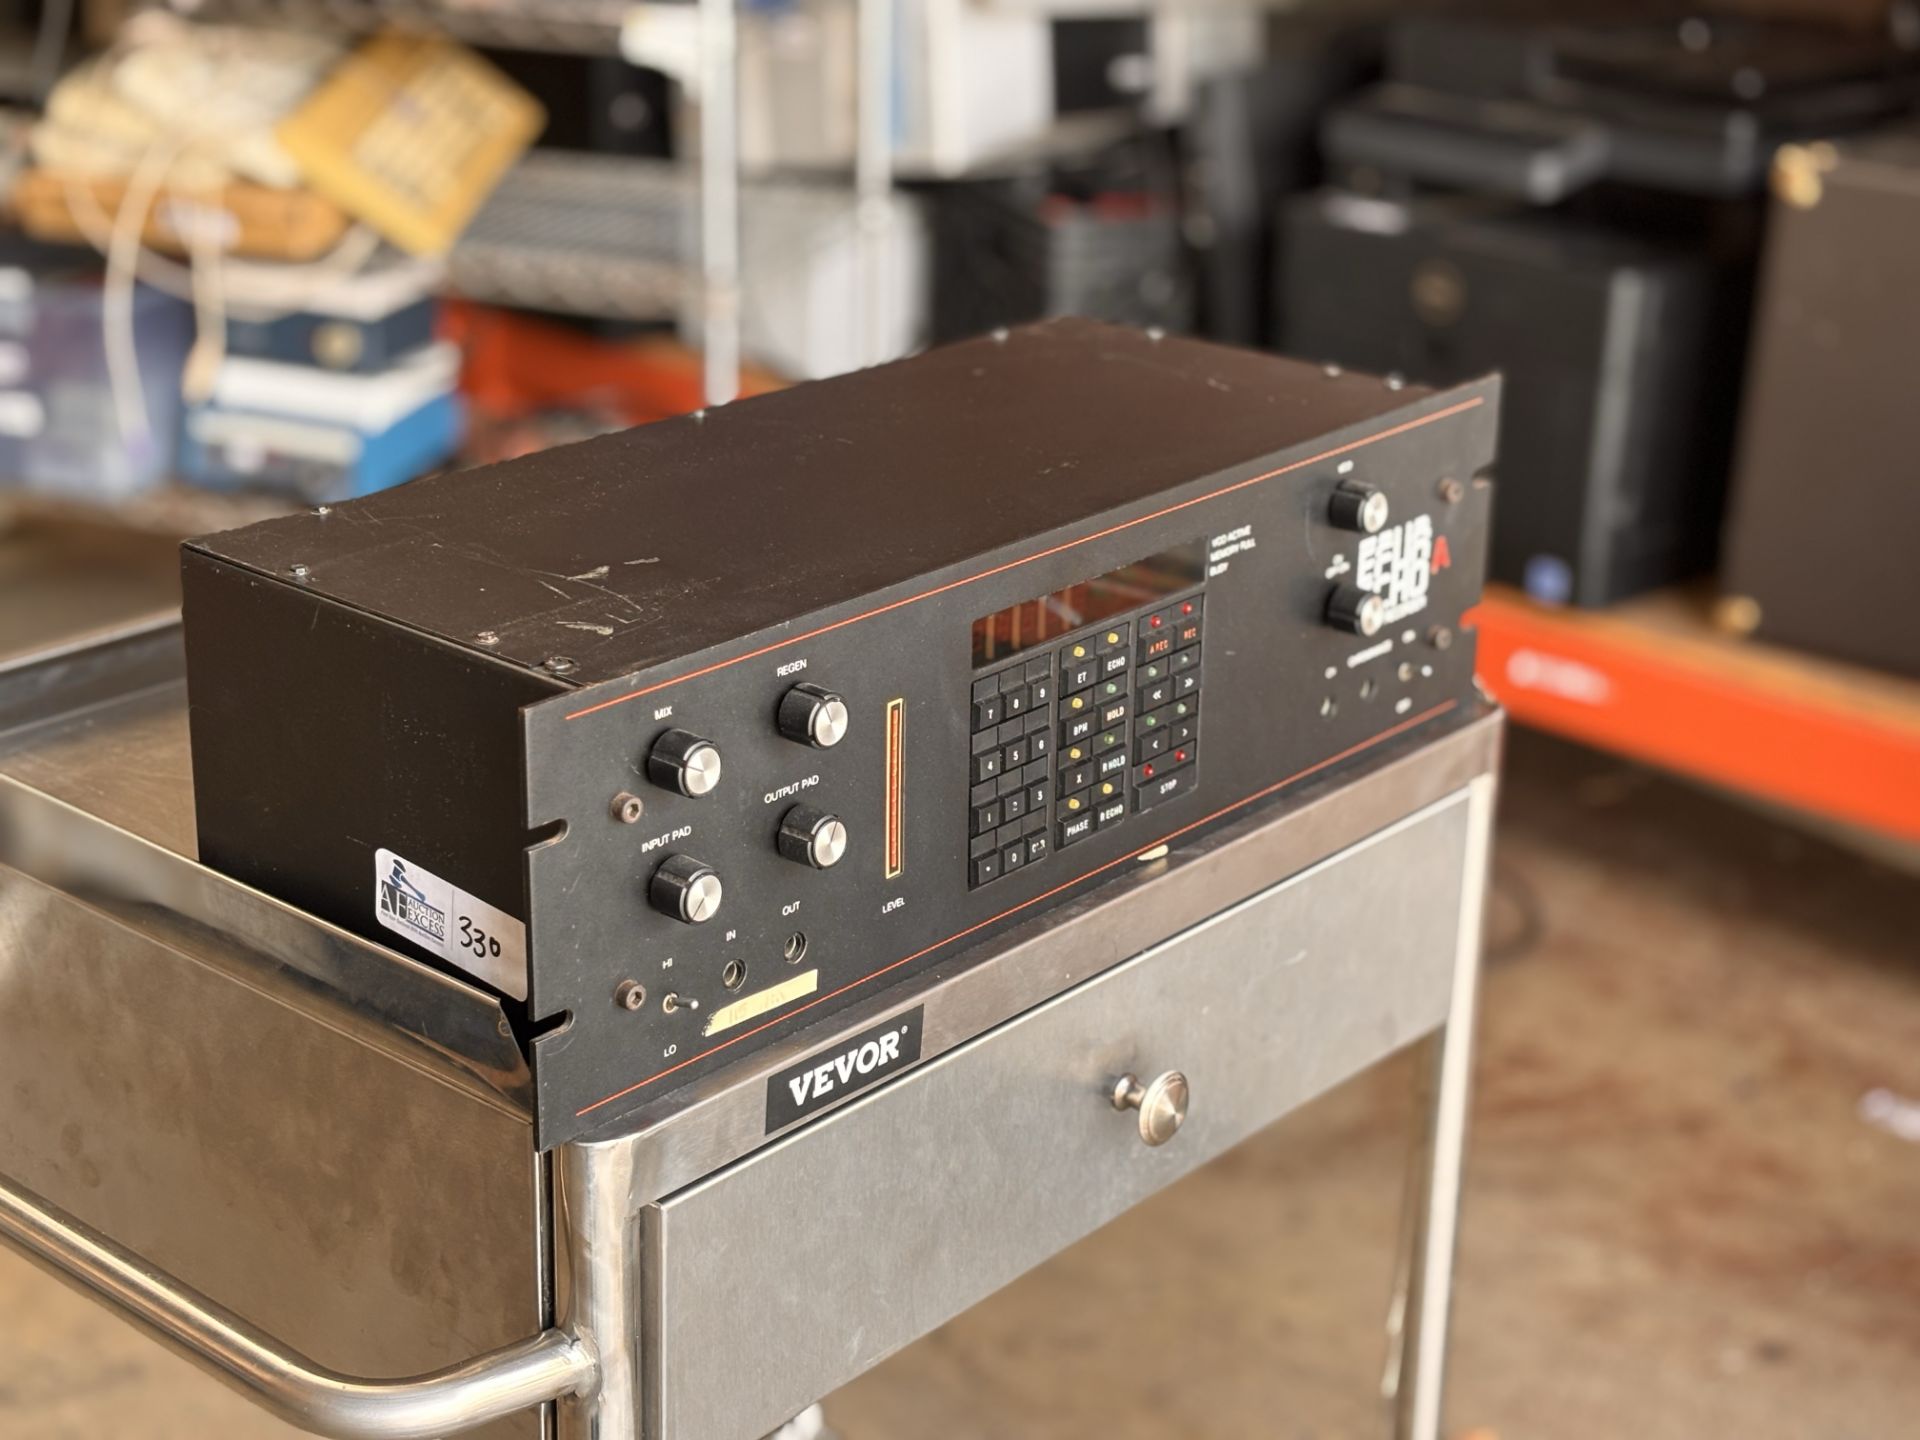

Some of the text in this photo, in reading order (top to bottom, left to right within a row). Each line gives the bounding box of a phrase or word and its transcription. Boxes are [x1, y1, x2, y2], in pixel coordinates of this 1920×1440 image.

[1240, 537, 1256, 551] FULL
[776, 658, 808, 678] REGEN
[1107, 655, 1126, 672] ECHO
[1077, 671, 1088, 684] ET
[1039, 687, 1046, 698] 9
[1013, 698, 1020, 709] 8
[654, 705, 673, 721] MIX
[1106, 705, 1125, 721] HOLD
[1073, 721, 1089, 736] BPM
[1038, 739, 1045, 750] 6
[1013, 750, 1019, 761] 5
[1108, 754, 1126, 770] HOLD
[987, 760, 994, 771] 4
[1076, 773, 1083, 784] X
[1160, 778, 1178, 795] STOP
[763, 774, 820, 804] OUTPUT PAD
[1105, 803, 1124, 820] ECHO
[1066, 819, 1089, 837] PHASE
[641, 825, 692, 853] INPUT PAD
[408, 898, 445, 925] AUCTION
[782, 900, 800, 916] OUT
[882, 897, 906, 914] LEVEL
[408, 908, 444, 937] EXCESS
[459, 916, 501, 957] 330
[725, 929, 737, 942] IN
[662, 957, 673, 970] HI
[663, 1044, 677, 1058] LO
